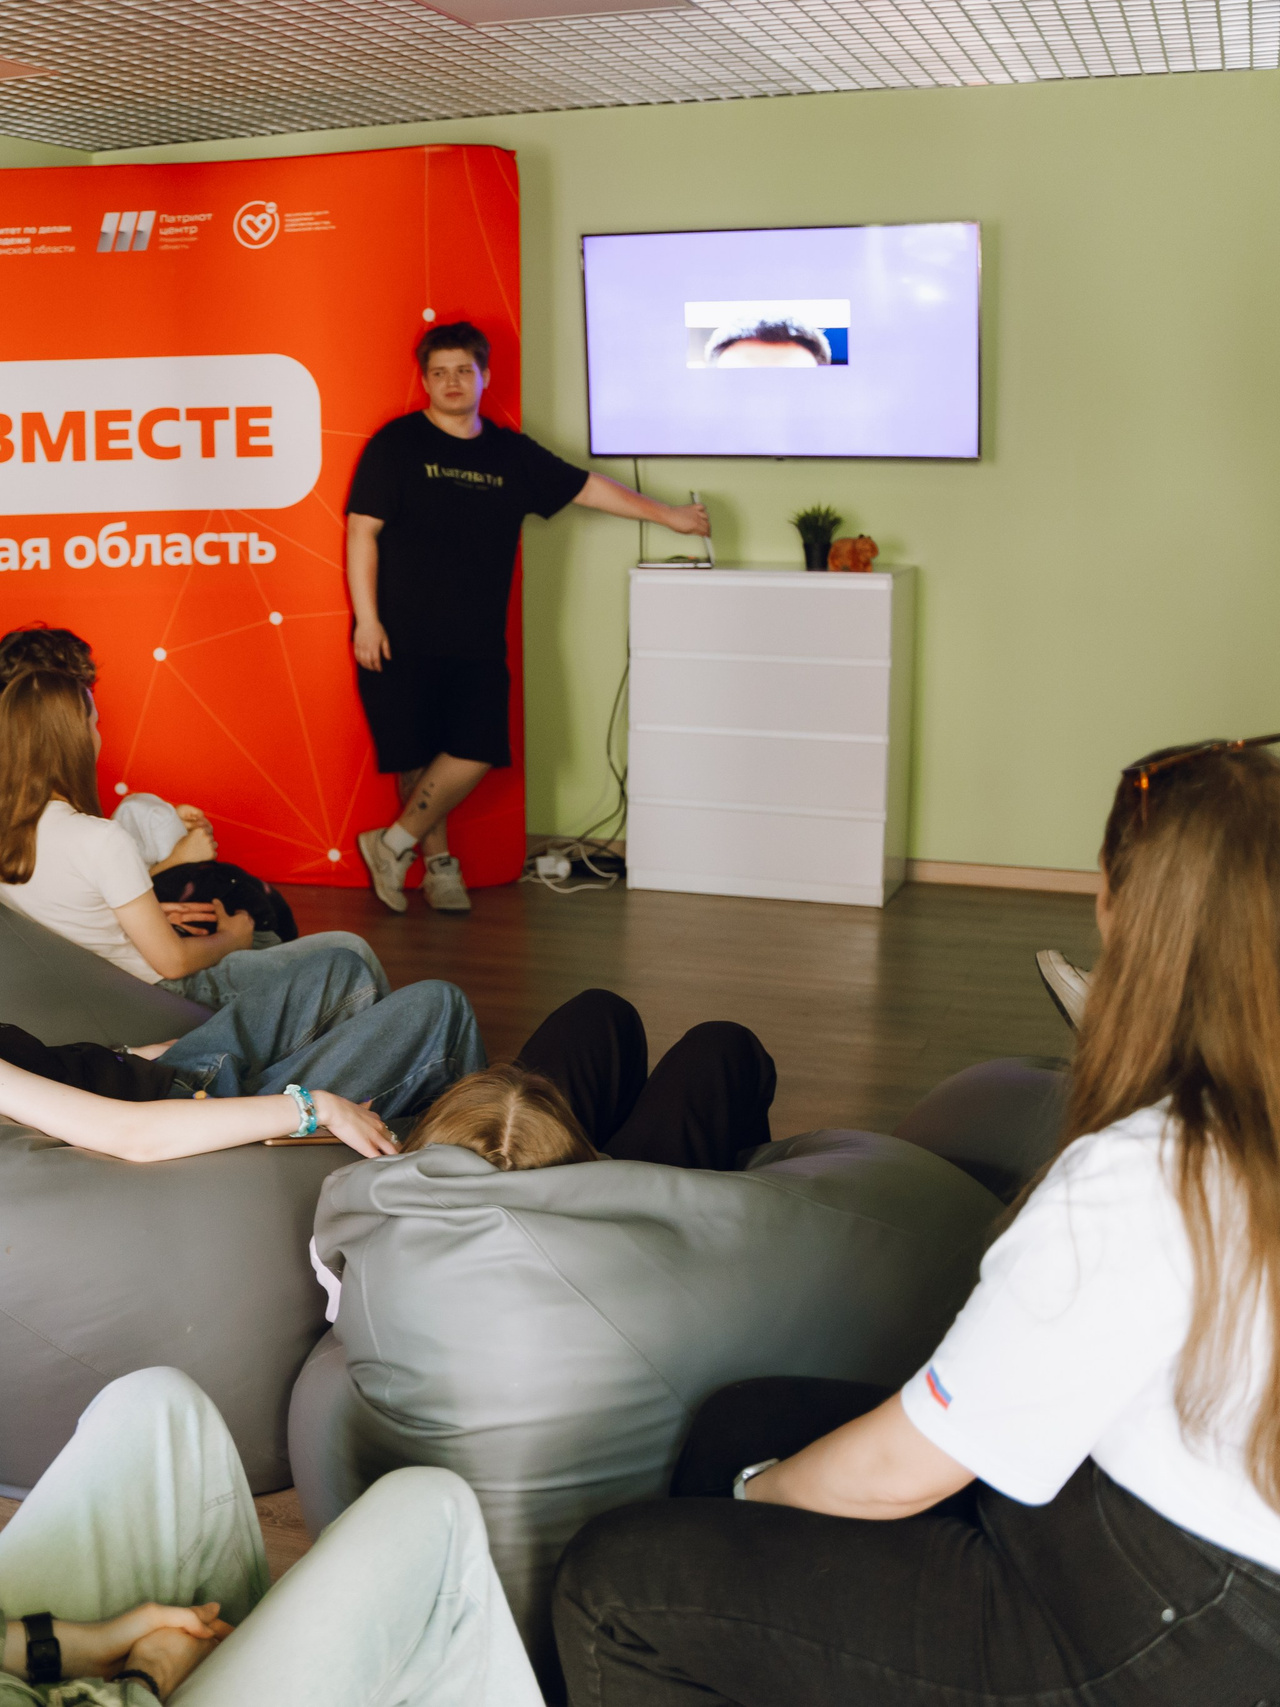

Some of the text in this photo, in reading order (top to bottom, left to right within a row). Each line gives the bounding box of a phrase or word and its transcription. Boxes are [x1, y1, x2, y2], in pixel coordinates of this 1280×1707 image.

[159, 213, 213, 223] Патриот
[159, 225, 198, 235] центр
[32, 245, 76, 254] области
[63, 522, 277, 569] область
